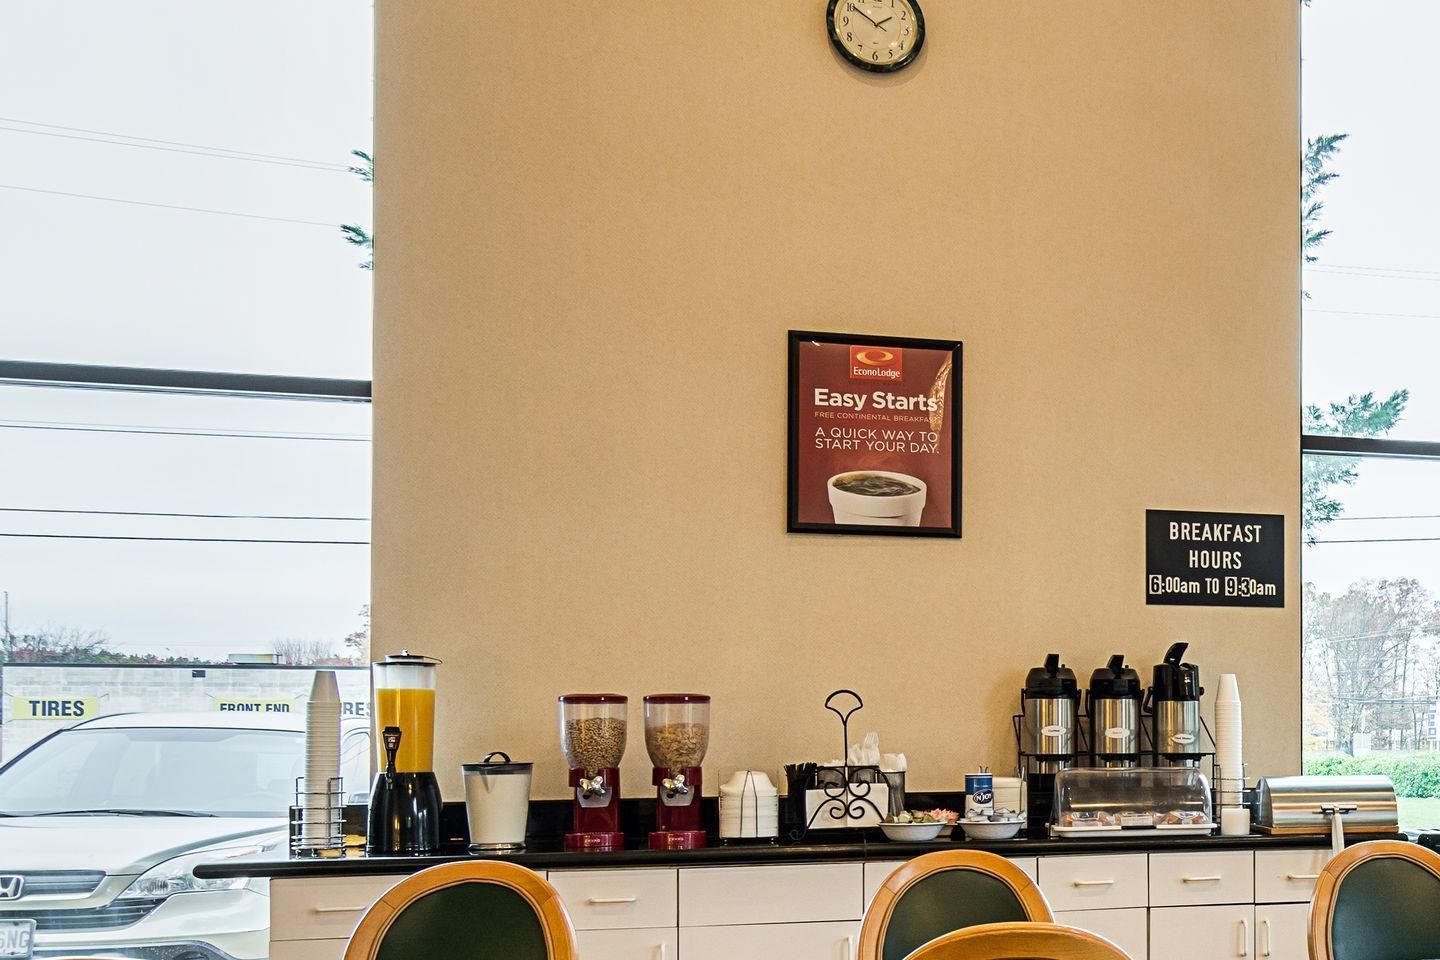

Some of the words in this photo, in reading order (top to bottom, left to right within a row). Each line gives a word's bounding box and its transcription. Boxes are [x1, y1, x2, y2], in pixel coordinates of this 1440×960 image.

[843, 16, 849, 27] 9
[901, 10, 907, 21] 2
[846, 32, 853, 42] 8
[872, 50, 879, 61] 6
[888, 49, 894, 59] 5
[814, 388, 868, 411] Easy
[871, 391, 938, 412] Starts
[814, 411, 835, 419] FREE
[837, 412, 891, 421] CONTINENTAL
[815, 426, 826, 438] A
[830, 427, 878, 440] QUICK
[881, 429, 915, 441] WAY
[919, 431, 938, 443] TO
[815, 438, 861, 450] START
[865, 440, 906, 453] YOUR
[910, 442, 940, 454] DAY.
[1169, 521, 1262, 543] BREAKFAST
[1188, 550, 1242, 570] HOURS
[1149, 574, 1200, 595] 6:00am
[1204, 577, 1220, 594] TO
[1224, 576, 1277, 597] 9:30am
[28, 700, 85, 717] TIRES
[219, 703, 262, 713] FRONT
[265, 703, 290, 713] END
